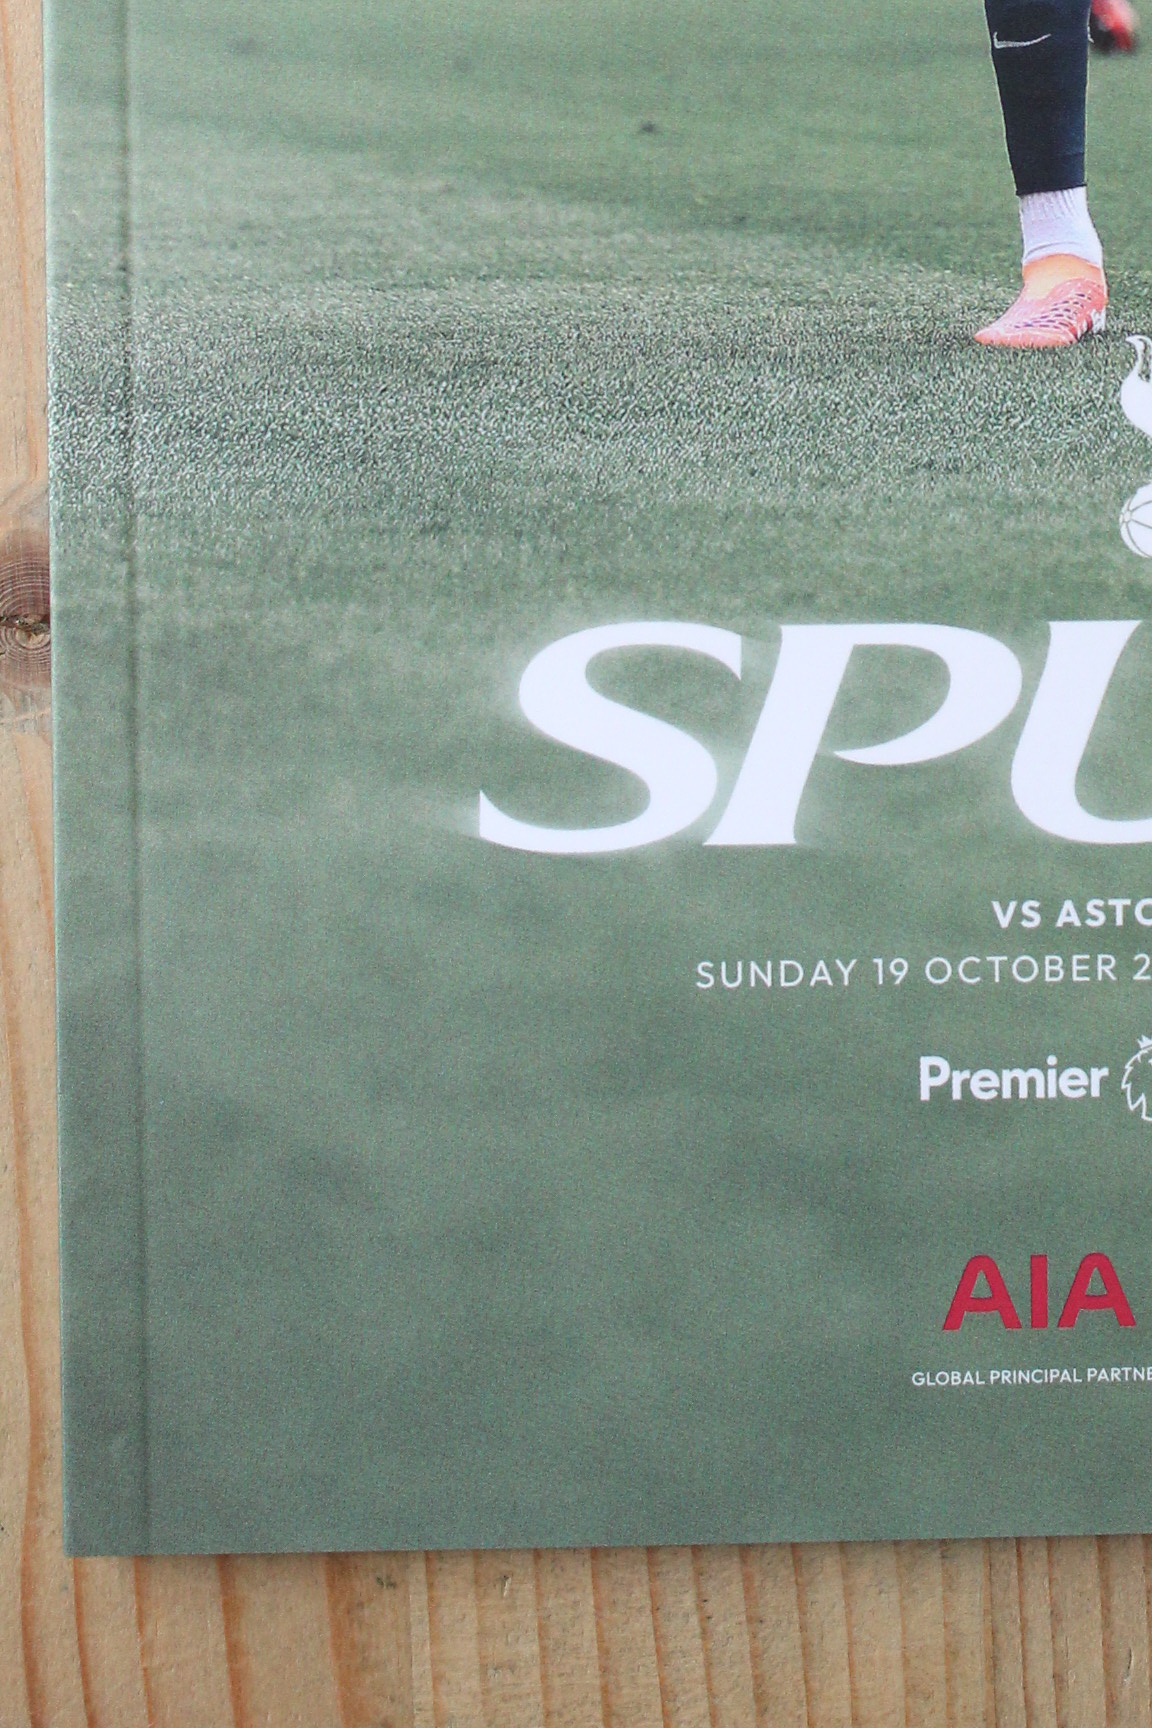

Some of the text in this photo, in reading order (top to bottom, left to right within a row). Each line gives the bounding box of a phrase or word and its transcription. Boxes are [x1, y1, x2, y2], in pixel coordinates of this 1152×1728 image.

[990, 899, 1042, 929] VS
[695, 957, 858, 990] SUNDAY
[872, 957, 909, 985] 19
[924, 953, 1118, 985] OCTOBER
[919, 1054, 1110, 1101] Premier
[943, 1252, 1136, 1331] AIA
[911, 1371, 985, 1387] GLOBAL
[989, 1368, 1083, 1385] PRINCIPAL
